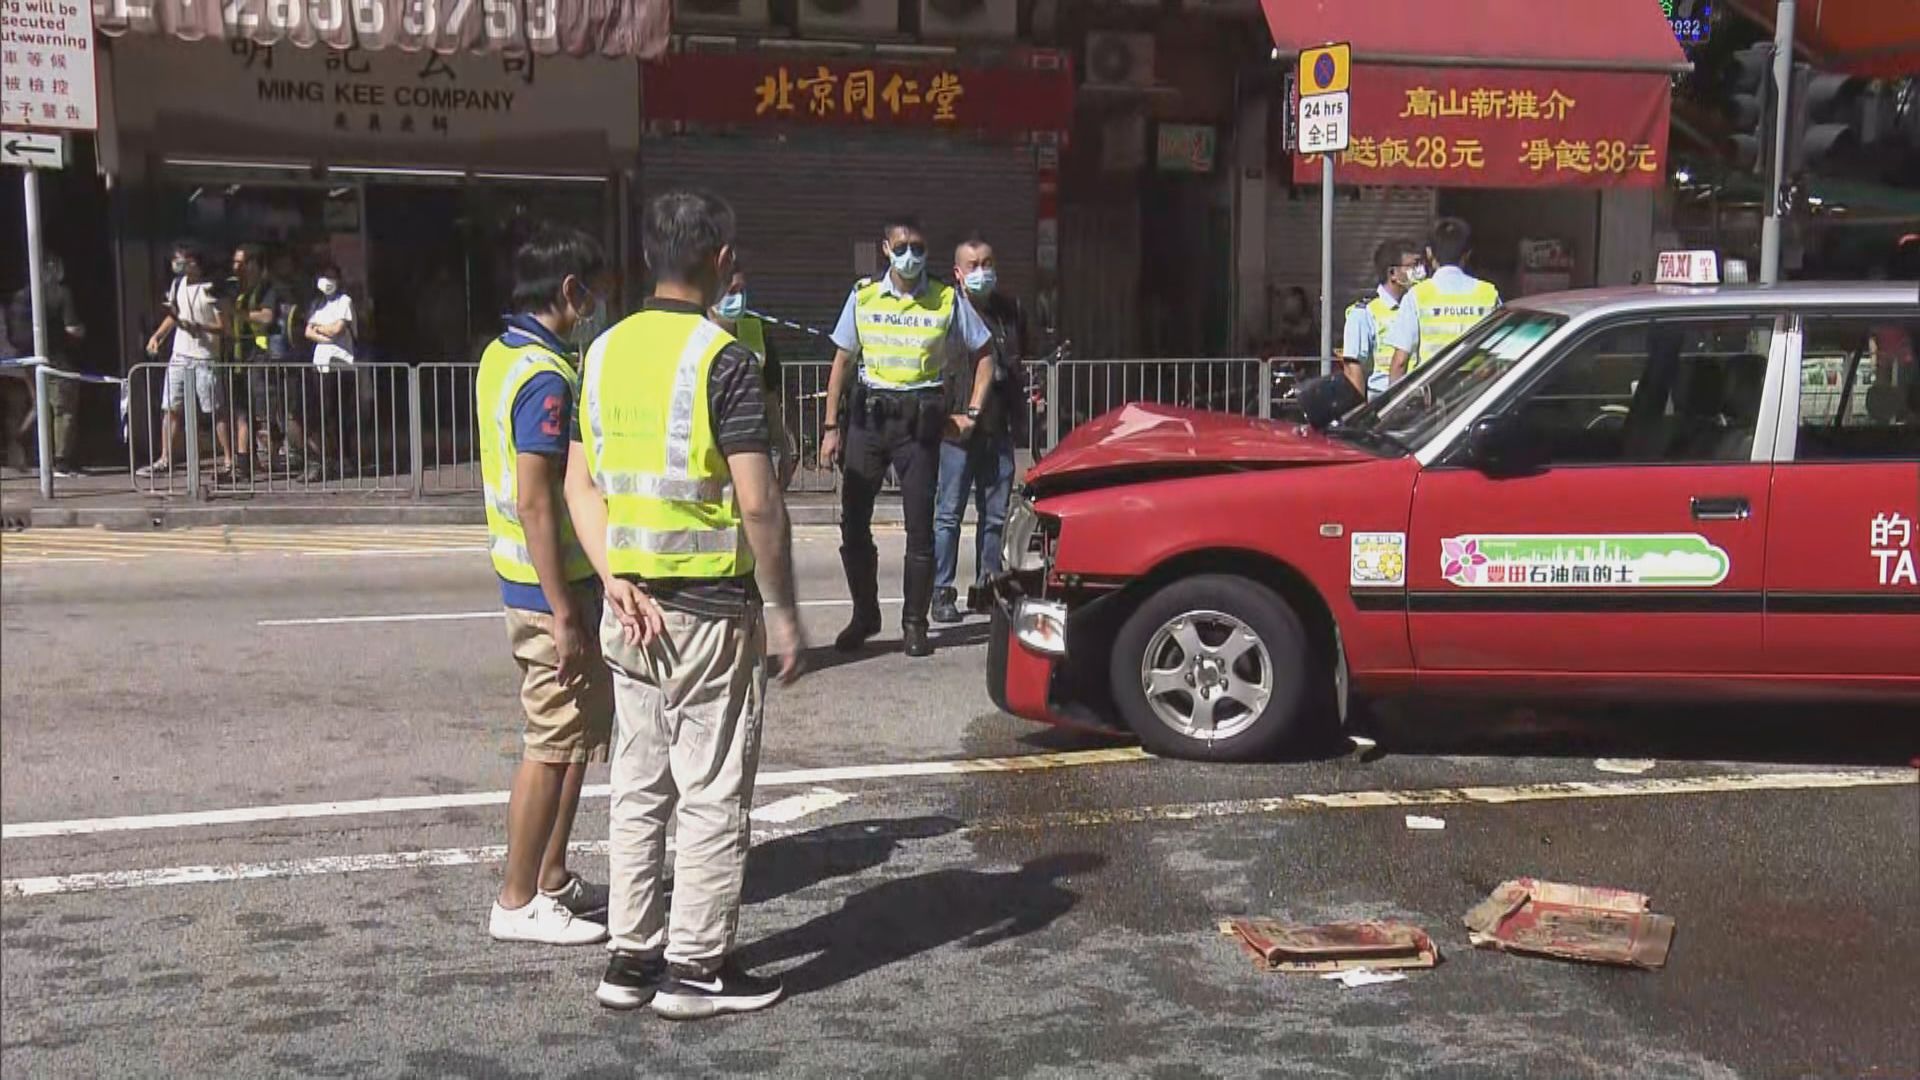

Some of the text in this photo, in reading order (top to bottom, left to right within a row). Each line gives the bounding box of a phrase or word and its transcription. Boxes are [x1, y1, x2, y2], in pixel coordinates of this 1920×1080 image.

[25, 0, 54, 13] will
[59, 4, 77, 15] be
[21, 33, 87, 49] warning
[258, 78, 514, 111] MING KEE COMPANY
[755, 66, 964, 120] 北京同仁堂
[1304, 100, 1343, 118] 24 hrs
[1399, 86, 1576, 121] 高山新推介
[1660, 254, 1692, 278] TAXI
[885, 313, 919, 327] POLICE
[1444, 306, 1474, 316] POLICE
[1487, 563, 1633, 583] 豐田石油氣的士
